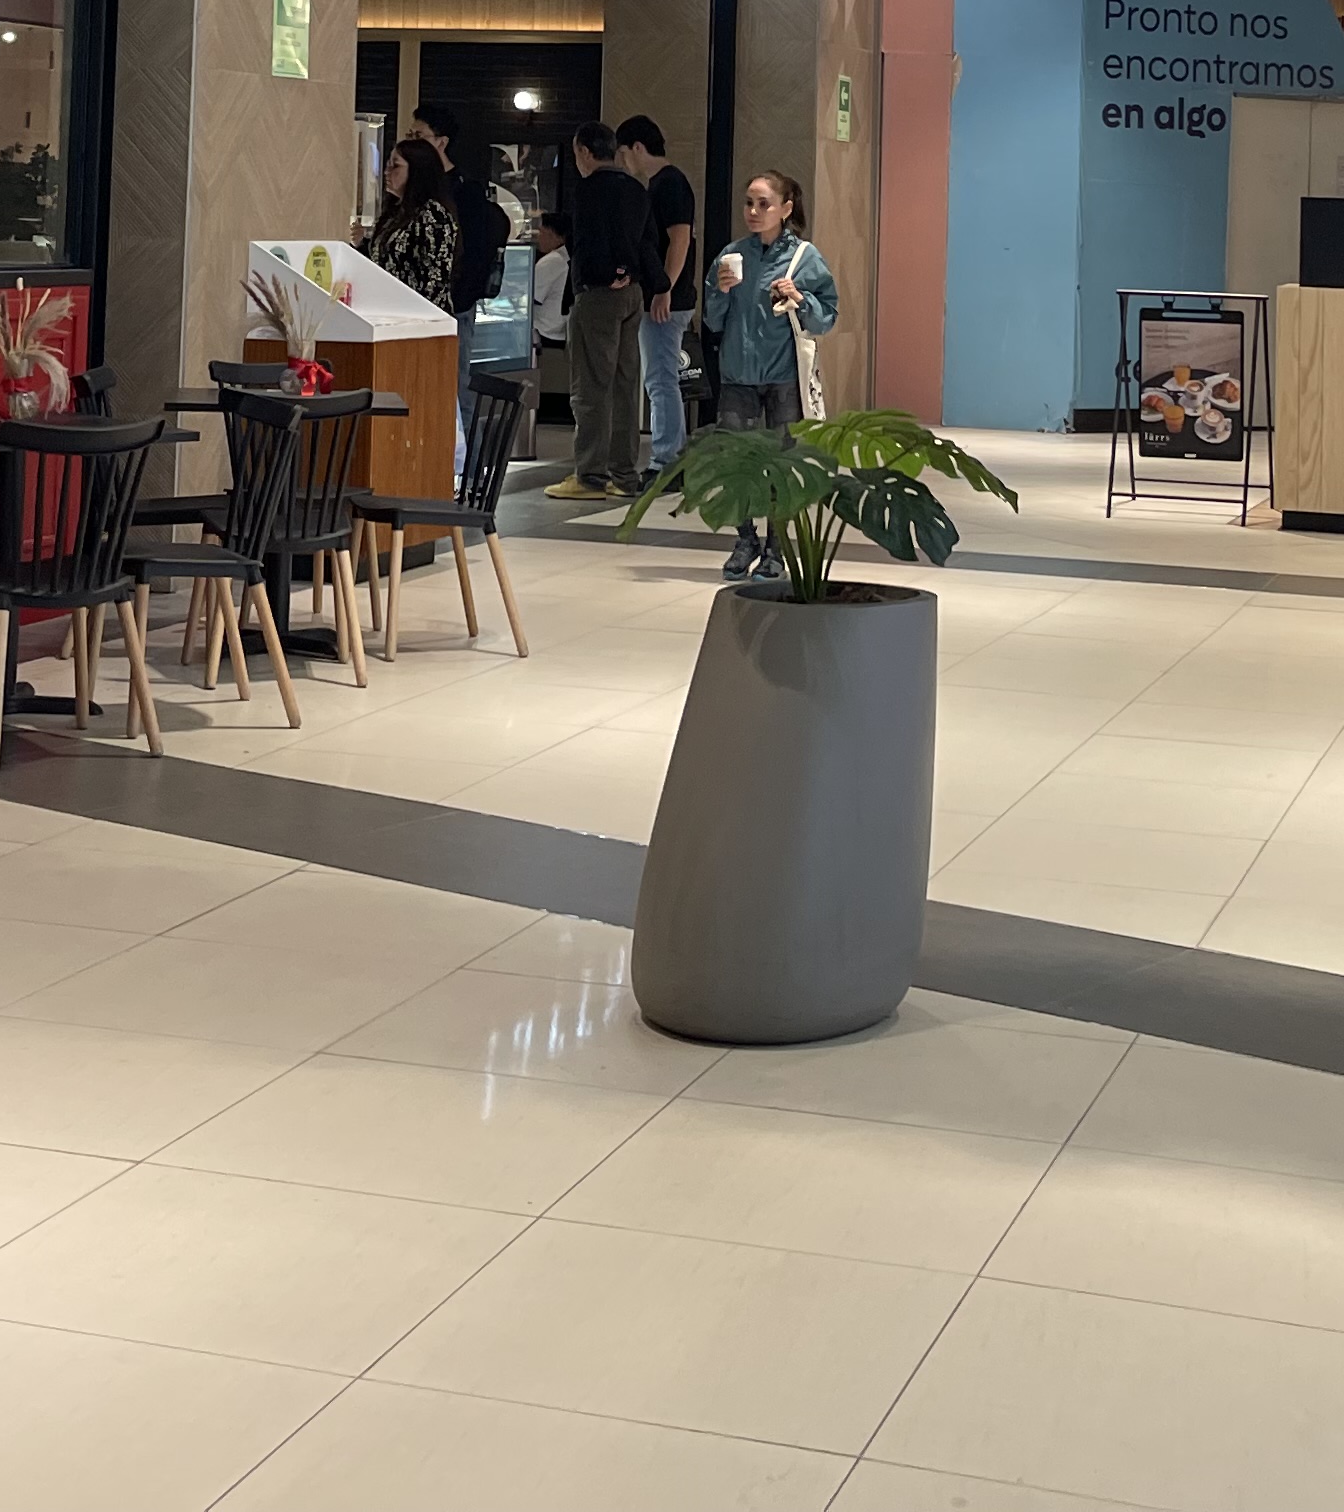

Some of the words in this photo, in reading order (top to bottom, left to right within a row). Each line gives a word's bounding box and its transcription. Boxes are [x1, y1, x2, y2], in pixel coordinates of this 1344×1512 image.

[1230, 13, 1289, 39] nos
[1103, 54, 1335, 89] encontramos
[1102, 103, 1144, 129] en
[1154, 97, 1227, 138] algo
